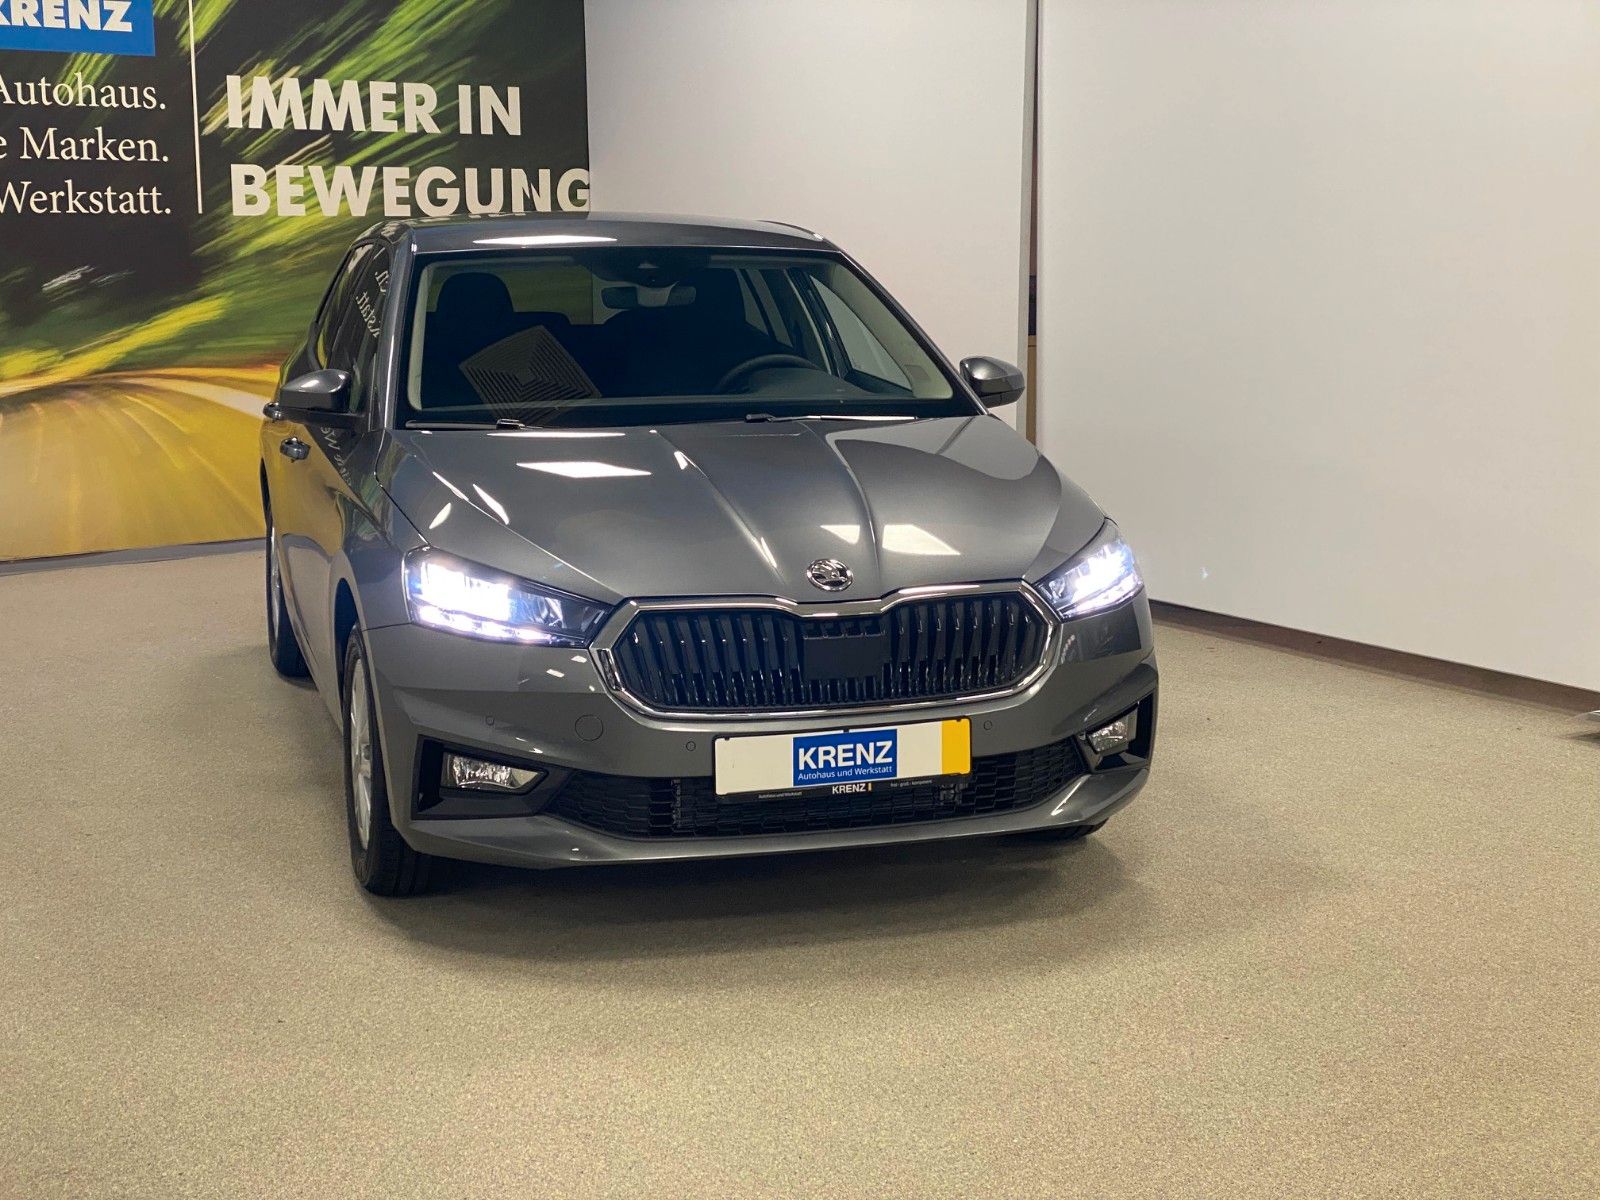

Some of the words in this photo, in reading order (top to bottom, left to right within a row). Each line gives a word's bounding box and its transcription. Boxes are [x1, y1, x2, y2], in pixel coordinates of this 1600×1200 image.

[226, 74, 441, 134] IMMER
[458, 84, 522, 136] IN
[19, 126, 169, 162] Marken.
[0, 179, 171, 214] Werkstatt.
[230, 163, 590, 217] BEWEGUNG
[798, 740, 893, 771] KRENZ
[797, 771, 836, 781] Autohaus
[836, 769, 853, 778] und
[854, 766, 893, 776] Werkstatt
[832, 783, 866, 795] KRENZ
